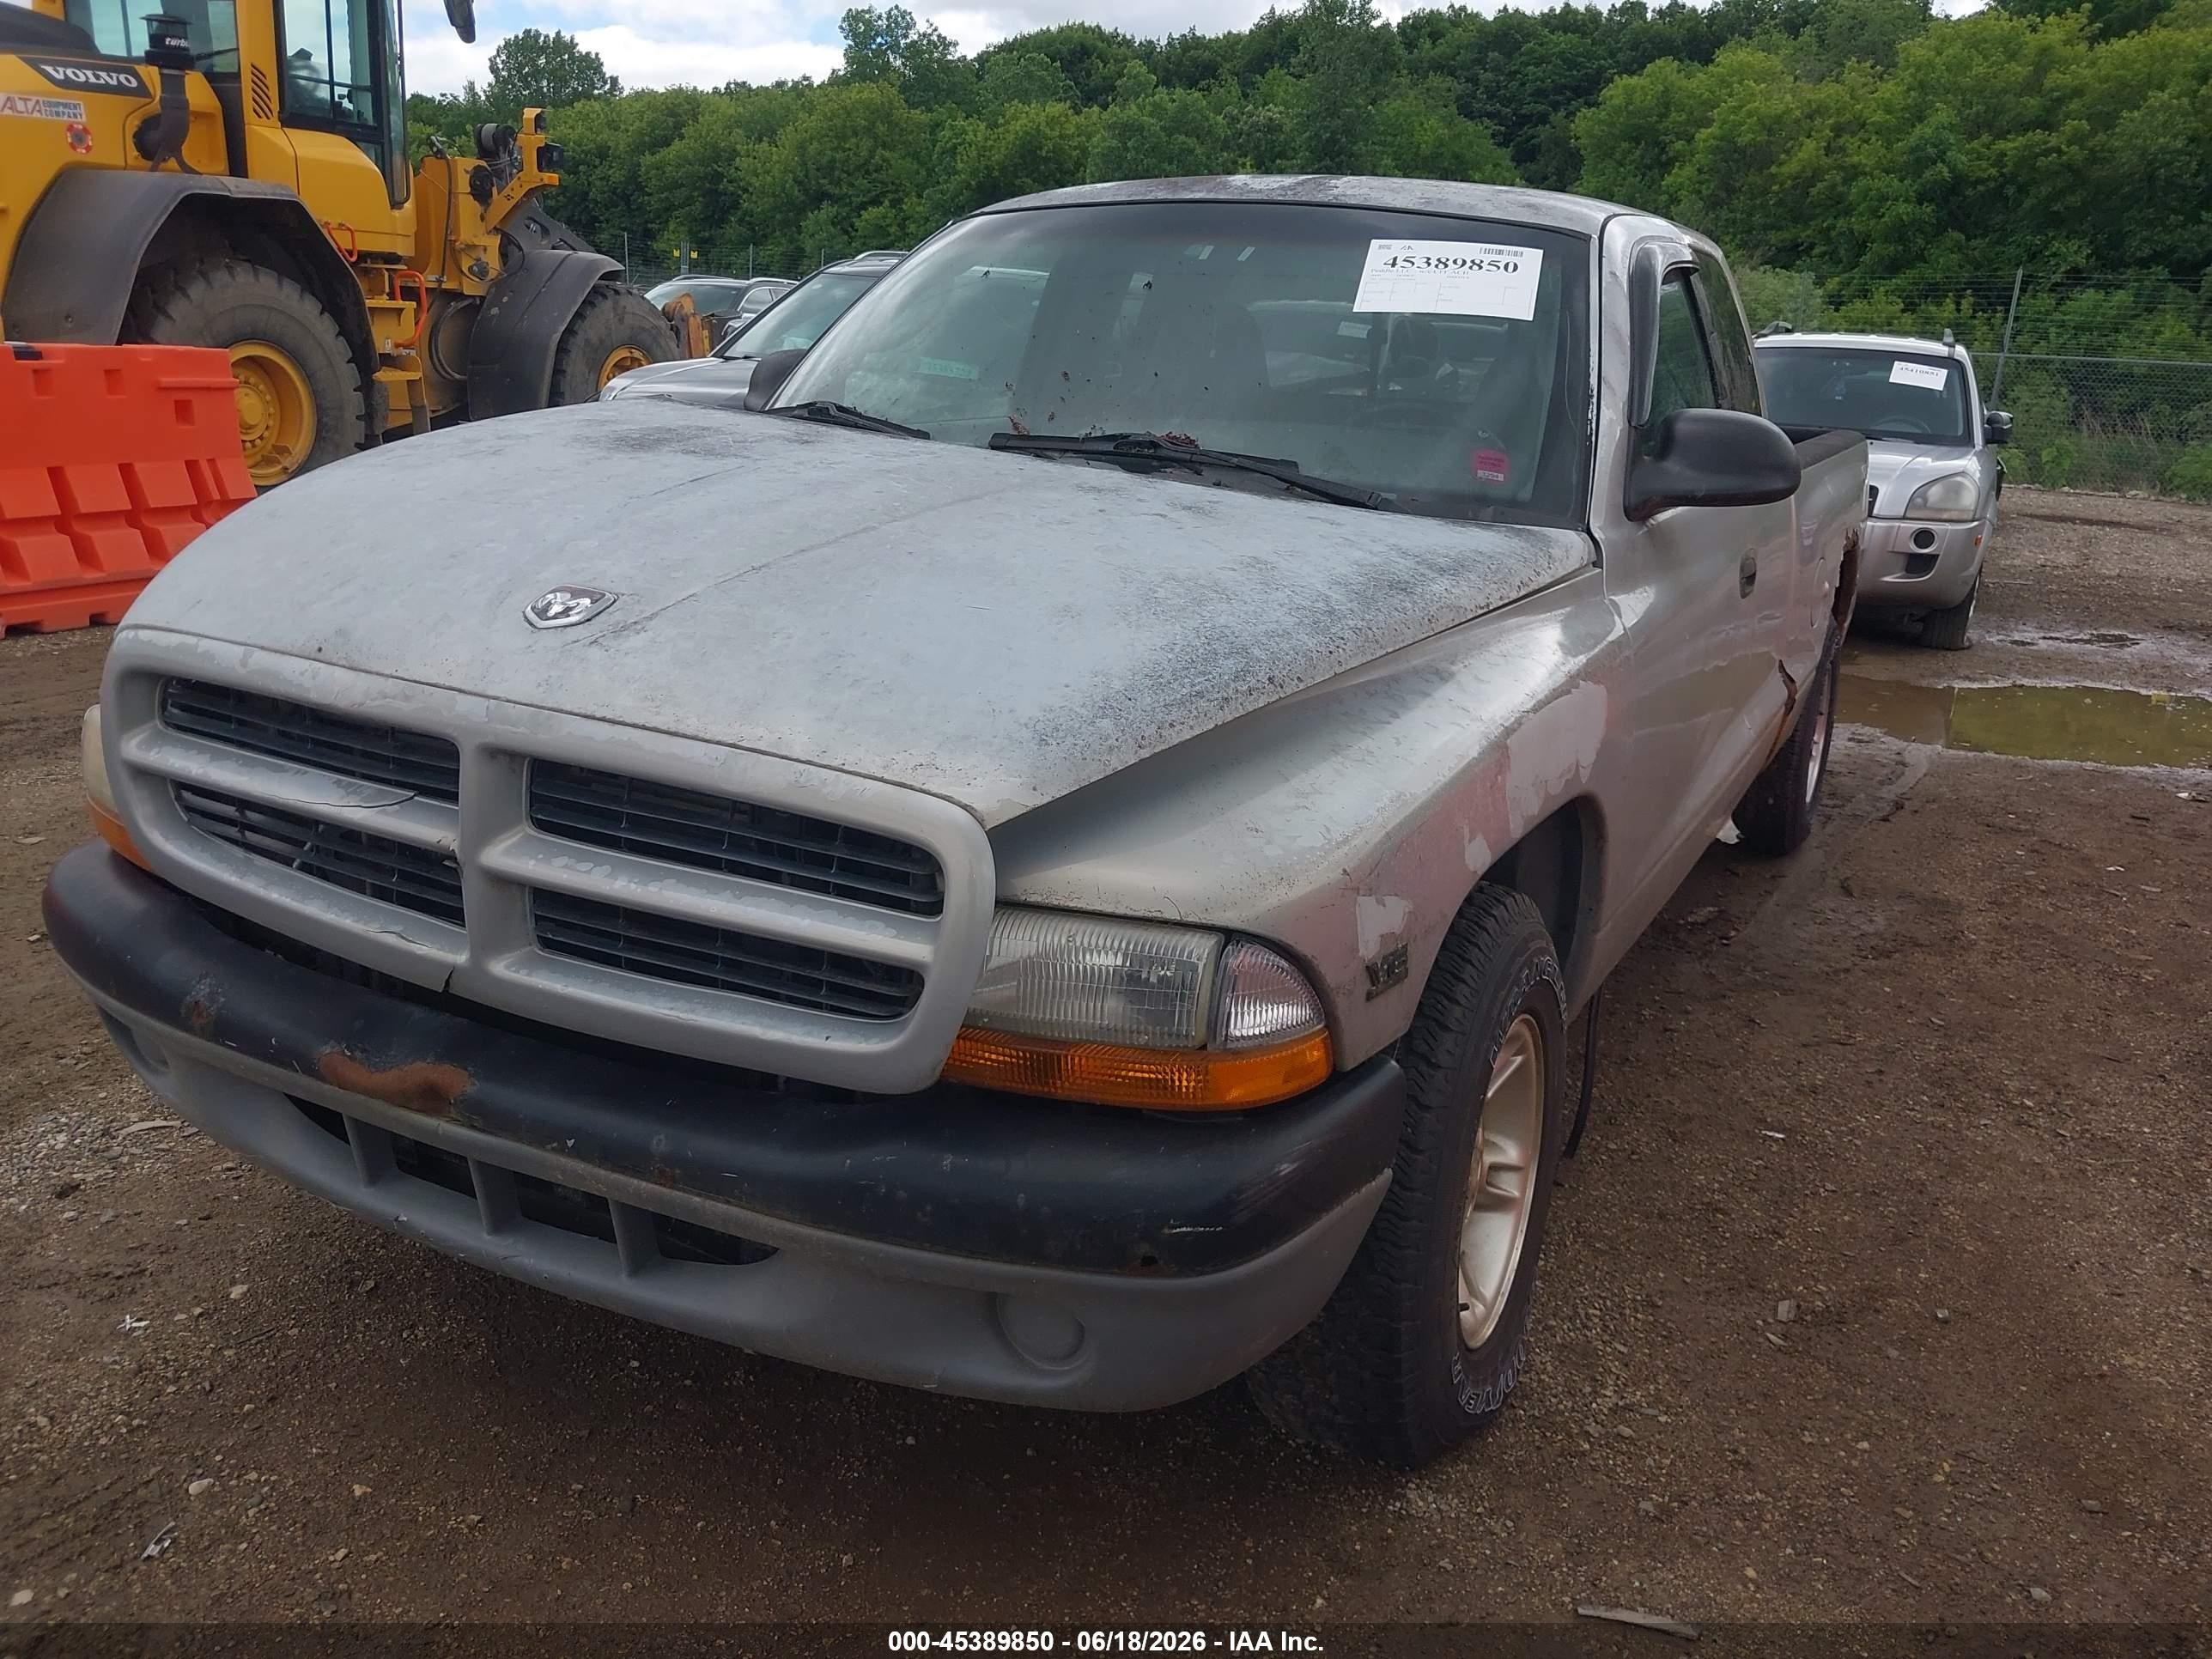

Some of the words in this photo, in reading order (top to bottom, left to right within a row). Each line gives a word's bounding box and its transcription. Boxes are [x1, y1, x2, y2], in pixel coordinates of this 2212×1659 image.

[40, 65, 138, 88] VOLVO
[0, 95, 43, 116] ALTA
[44, 109, 83, 120] COMPANY
[1382, 255, 1519, 275] 45389850
